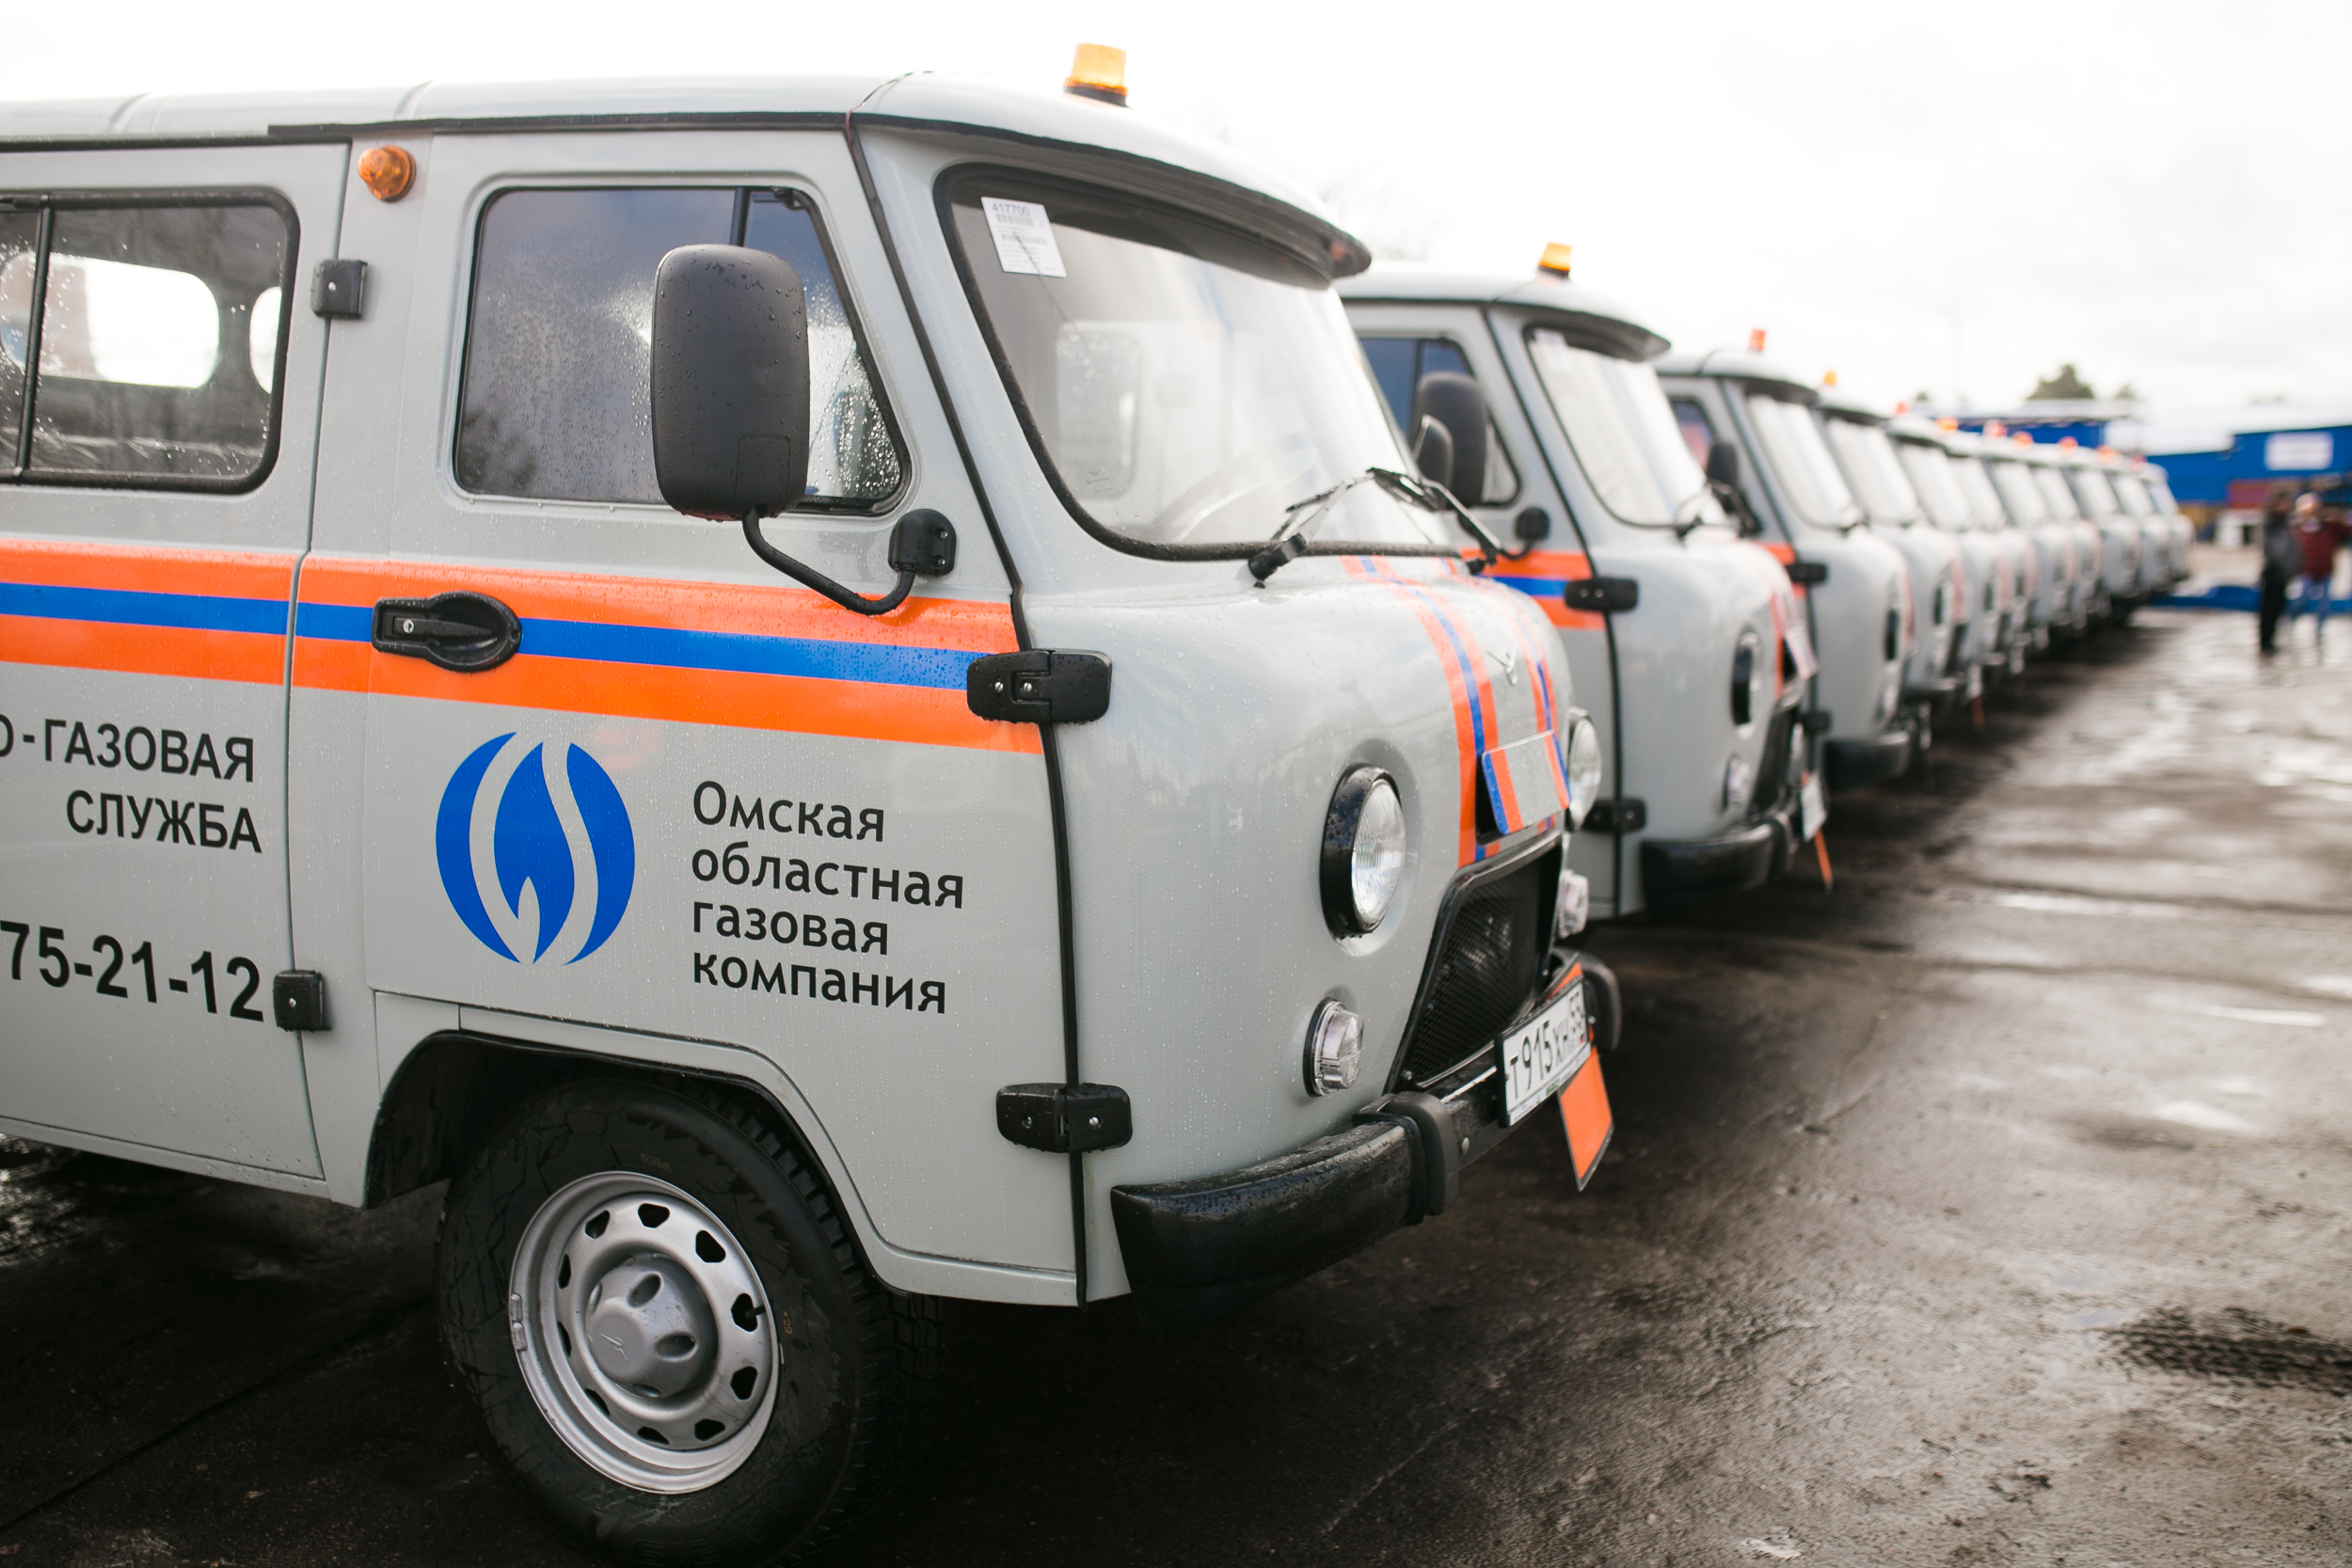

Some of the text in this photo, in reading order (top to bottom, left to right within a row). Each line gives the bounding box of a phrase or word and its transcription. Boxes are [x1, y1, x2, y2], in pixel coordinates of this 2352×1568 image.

[67, 789, 262, 854] СЛУЖБА
[693, 780, 884, 843] Омская
[691, 840, 964, 910] областная
[693, 901, 888, 956] газовая
[0, 919, 264, 1022] 75-21-12
[693, 952, 946, 1015] компания
